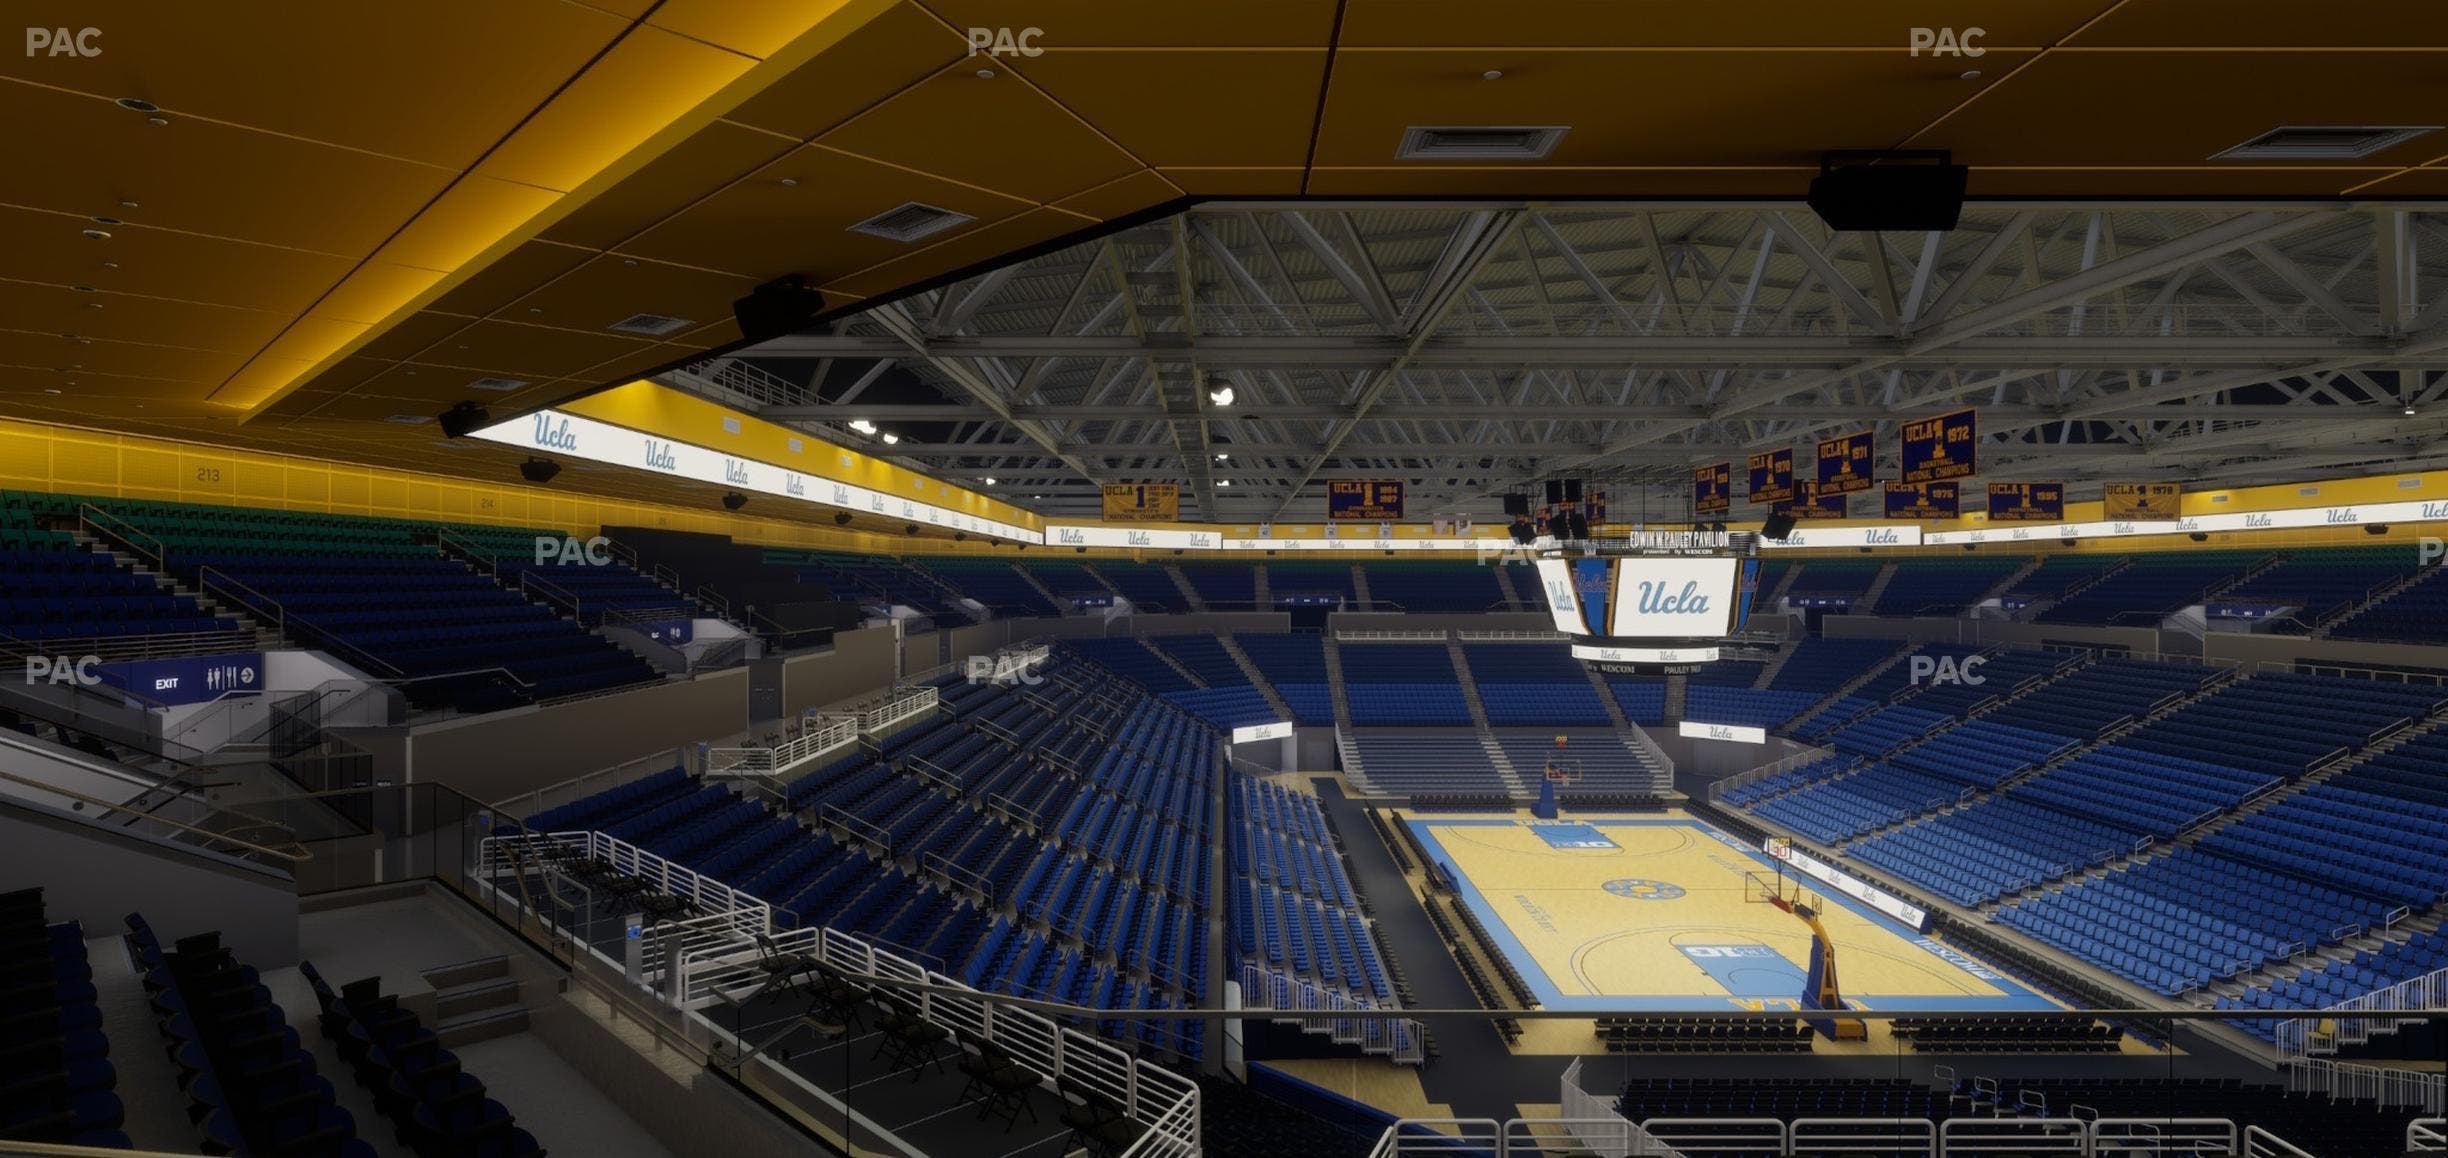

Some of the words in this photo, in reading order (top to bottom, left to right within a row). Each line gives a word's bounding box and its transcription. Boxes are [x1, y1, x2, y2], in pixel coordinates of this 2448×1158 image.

[534, 412, 577, 451] Ucla
[1906, 422, 1933, 442] UCLA
[1932, 419, 1946, 458] 1
[1947, 425, 1969, 443] 1972
[645, 440, 676, 471] Ucla
[1821, 441, 1841, 459] UCLA
[1852, 446, 1868, 460] 1971
[1749, 455, 1765, 470] UCLA
[198, 467, 220, 482] 213
[726, 458, 749, 485] Ucla
[1906, 469, 1932, 482] NATIONAL
[1935, 463, 1969, 478] CHAMPIONS
[786, 473, 804, 496] Ucla
[1105, 485, 1133, 496] UCLA
[1333, 483, 1362, 493] UCLA
[1990, 484, 2019, 494] UCLA
[2107, 485, 2135, 495] UCLA
[2326, 508, 2358, 523] Ucla
[2422, 501, 2448, 518] Ucl
[2175, 517, 2199, 531] Ucla
[2245, 513, 2272, 527] Ucla
[1059, 527, 1085, 544] Ucla
[2061, 526, 2079, 537] Ucla
[2114, 522, 2136, 534] Ucla
[1128, 531, 1151, 546] Ucla
[1189, 533, 1210, 547] Ucla
[1630, 531, 1655, 548] EDWIN
[1665, 531, 1692, 548] PAULEY
[1694, 531, 1730, 548] PAVILION
[1865, 528, 1899, 544] Ucla
[1548, 580, 1575, 612] Ucla
[1639, 580, 1711, 614] Ucla
[1601, 649, 1622, 660] Ucla
[1659, 650, 1678, 661] Ucla
[1664, 666, 1689, 674] PAULEY
[156, 678, 178, 690] EXIT
[1709, 726, 1733, 739] Ucla
